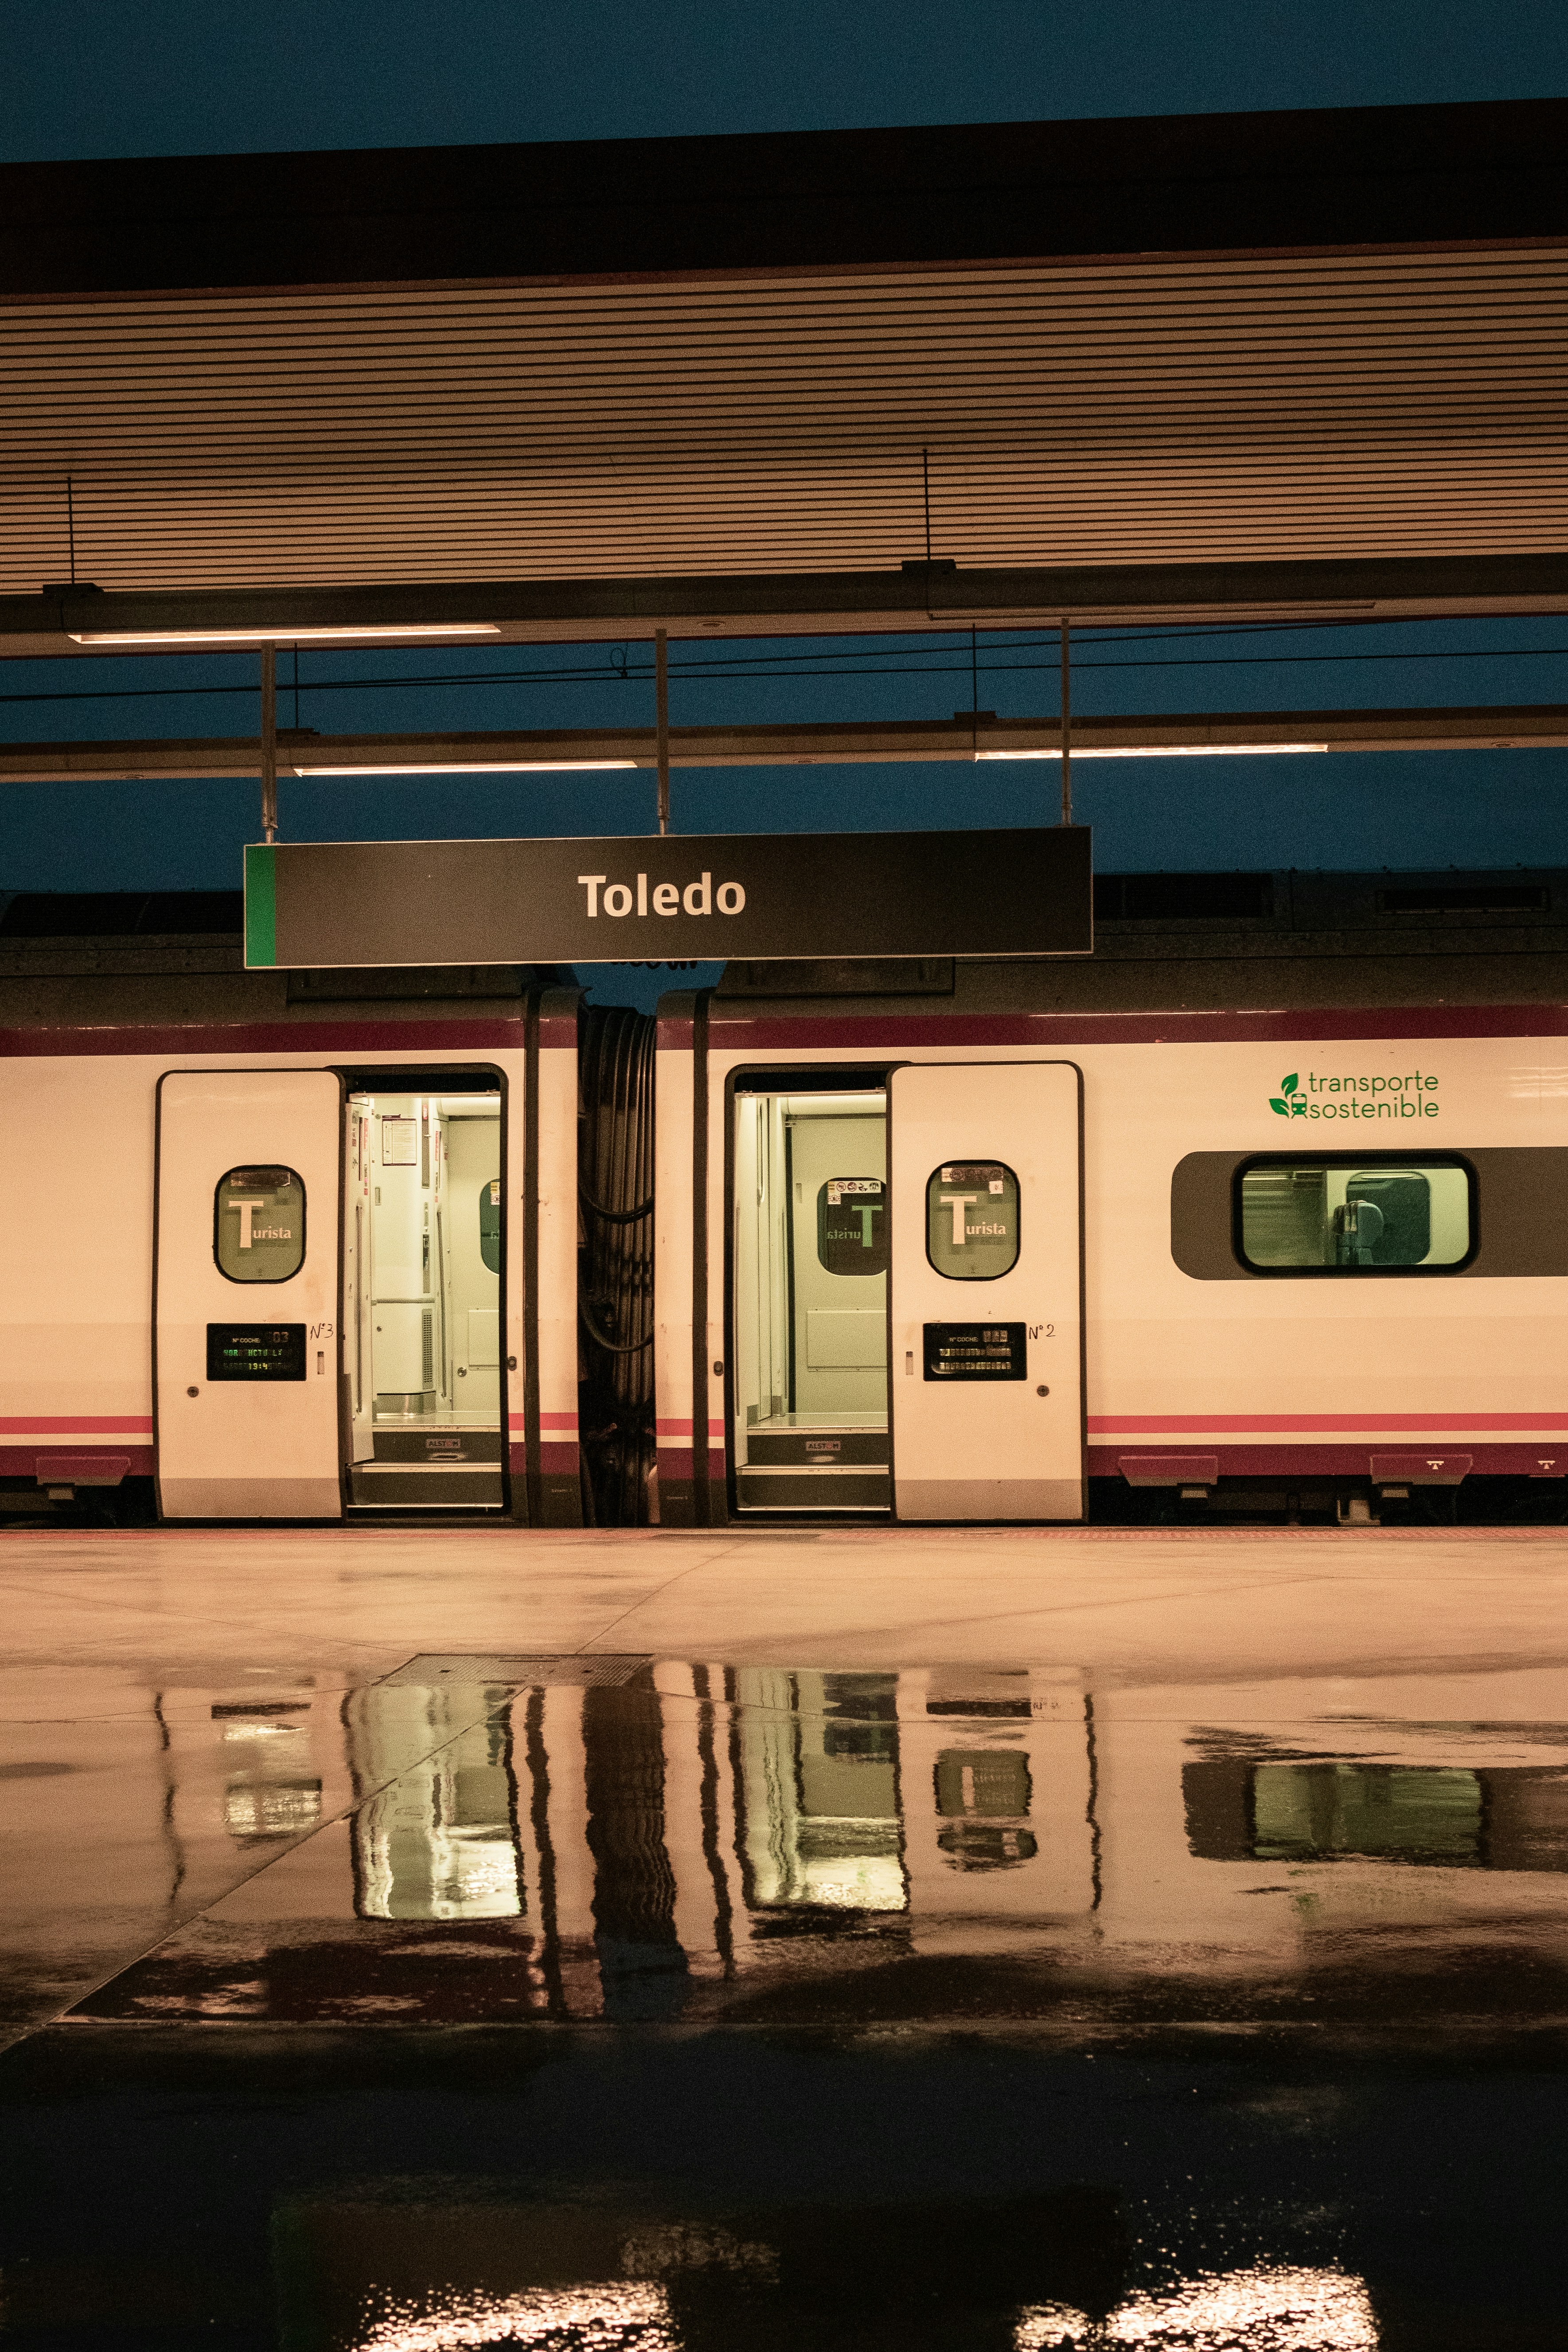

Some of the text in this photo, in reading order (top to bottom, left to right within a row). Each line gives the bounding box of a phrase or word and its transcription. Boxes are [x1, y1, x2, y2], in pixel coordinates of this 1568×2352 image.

[578, 872, 746, 917] Toledo
[1308, 1070, 1439, 1097] transporte
[1309, 1093, 1439, 1119] sostenible
[228, 1200, 292, 1248] Turista
[940, 1196, 1006, 1244] Turista
